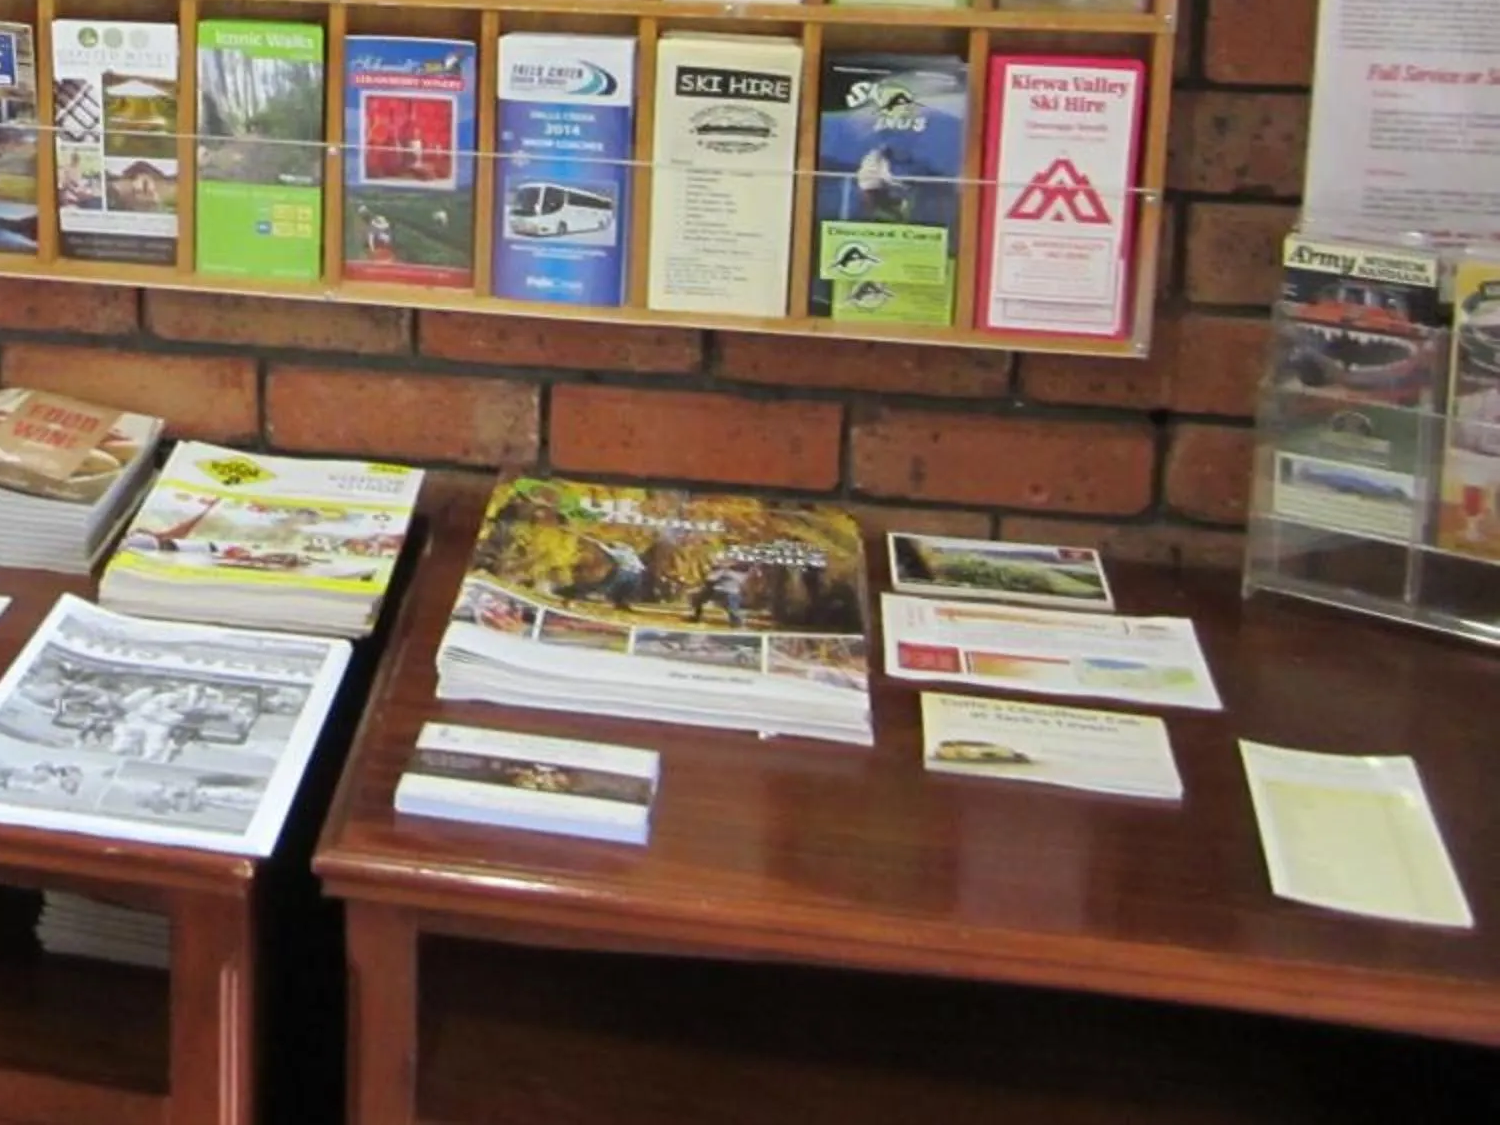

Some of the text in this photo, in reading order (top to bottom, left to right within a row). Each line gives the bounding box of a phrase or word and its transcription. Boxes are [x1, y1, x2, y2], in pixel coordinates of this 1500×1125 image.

[680, 74, 790, 99] SKI HIRE
[1011, 75, 1128, 99] Kiewa Valley
[1030, 95, 1107, 113] Ski Hire
[1289, 244, 1357, 275] Army
